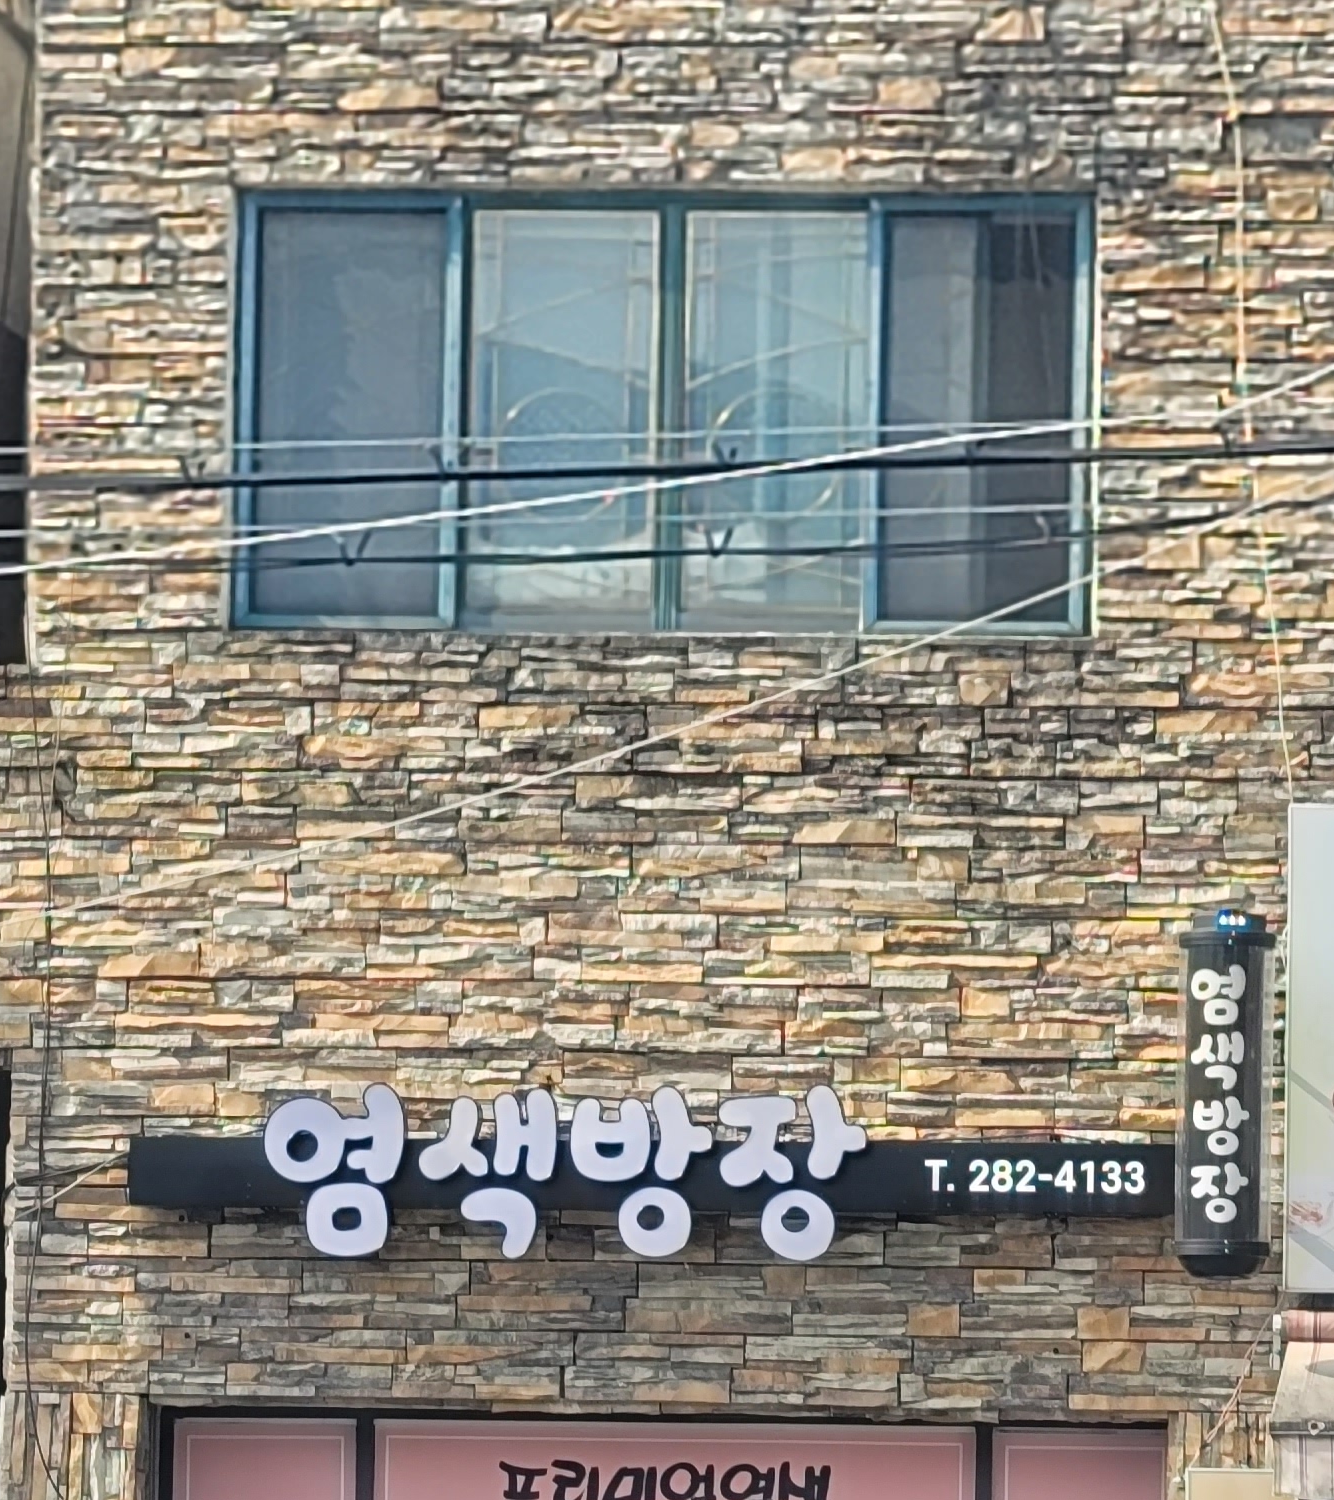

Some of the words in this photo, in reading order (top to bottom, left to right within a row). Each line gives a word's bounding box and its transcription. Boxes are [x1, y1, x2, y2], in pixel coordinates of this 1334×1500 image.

[264, 1082, 865, 1262] 염색방장
[924, 1159, 958, 1192] T.
[968, 1158, 1146, 1195] 282-4133
[1190, 964, 1249, 1224] 염색방장
